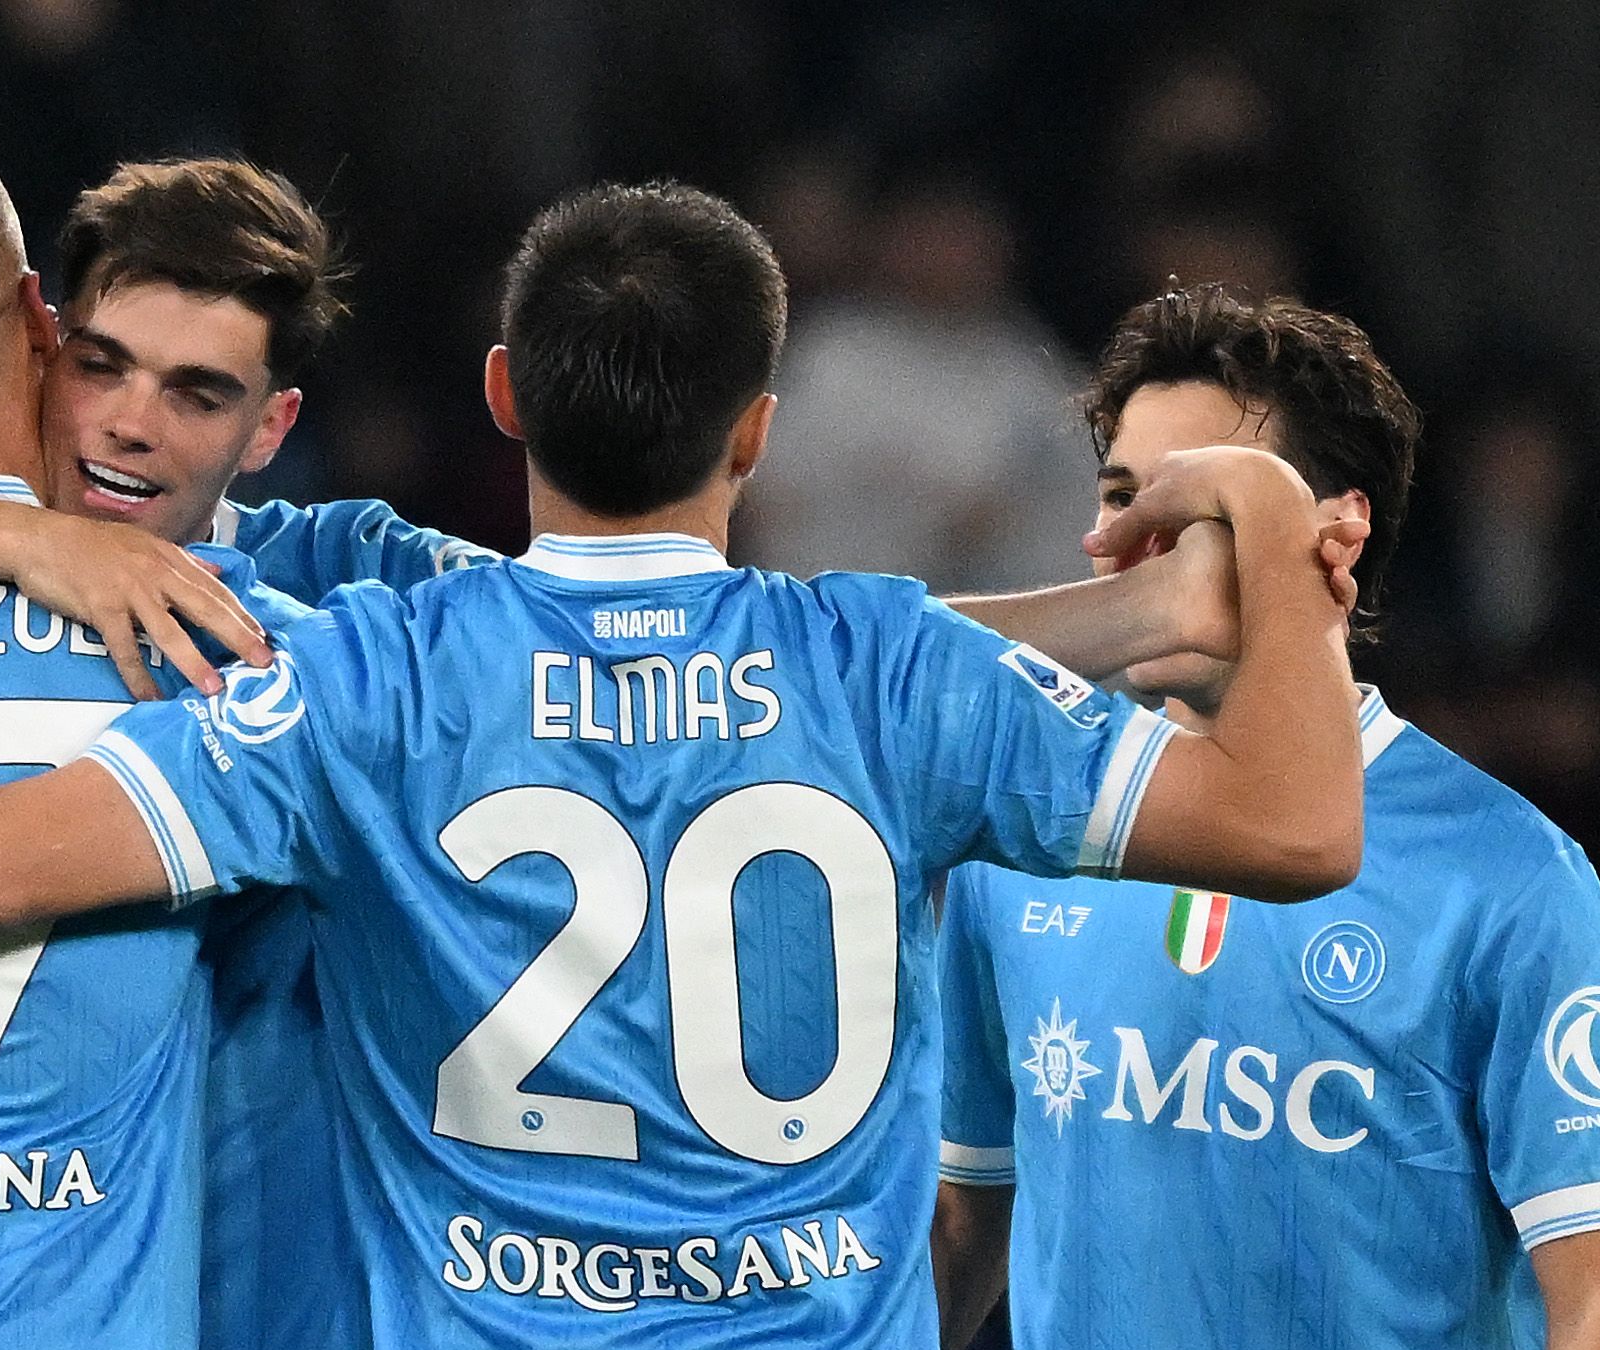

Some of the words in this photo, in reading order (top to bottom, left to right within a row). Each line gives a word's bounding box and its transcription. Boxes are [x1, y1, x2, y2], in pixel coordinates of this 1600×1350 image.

[613, 608, 686, 638] NAPOLI
[532, 649, 781, 745] ELMAS
[1021, 901, 1093, 937] EA7
[1323, 942, 1366, 984] N
[432, 782, 898, 1165] 20
[1101, 1026, 1375, 1153] MSC
[442, 1214, 882, 1312] SORGESANA
